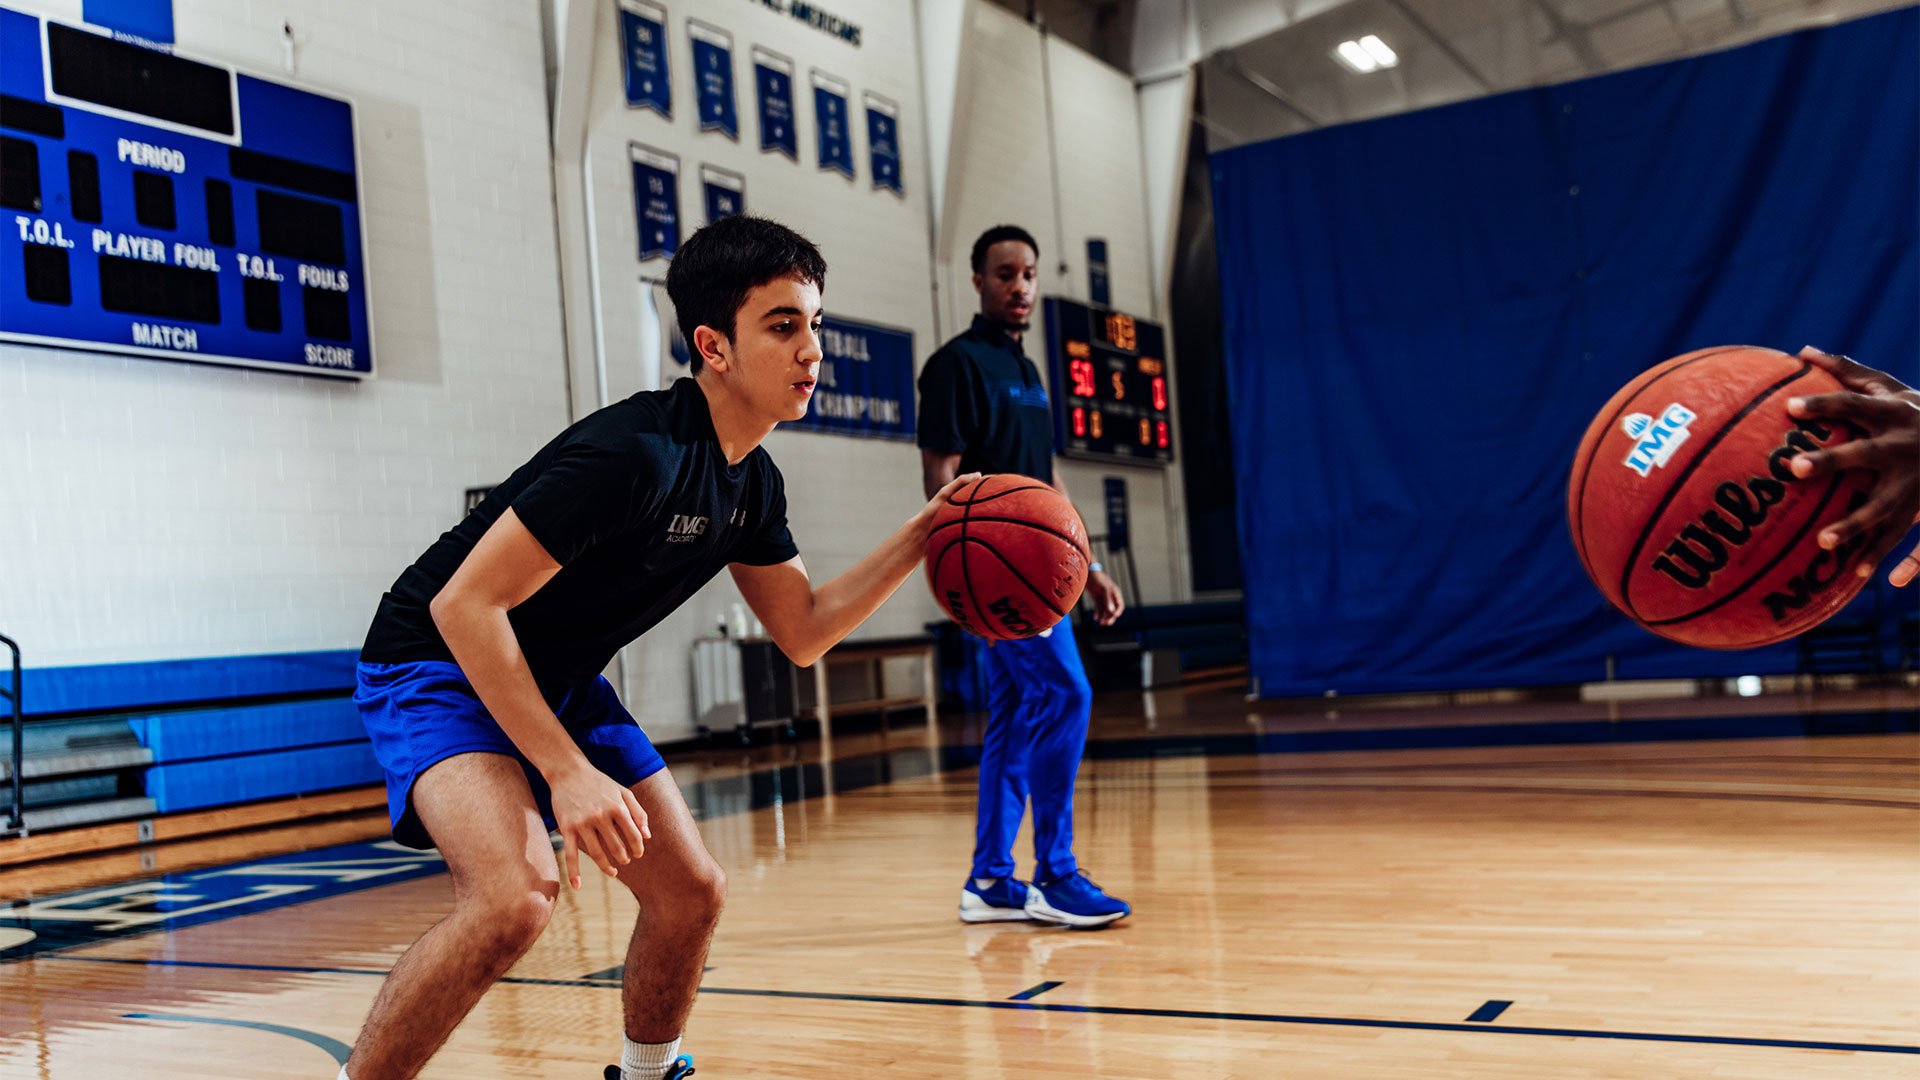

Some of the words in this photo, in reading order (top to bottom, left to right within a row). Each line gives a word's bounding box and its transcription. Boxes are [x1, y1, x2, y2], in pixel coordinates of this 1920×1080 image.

[117, 137, 186, 174] PERIOD
[15, 215, 75, 250] T.O.L.
[92, 228, 166, 263] PLAYER
[174, 242, 221, 272] FOUL
[237, 252, 284, 282] T.O.L.
[298, 263, 349, 292] FOULS
[131, 322, 198, 350] MATCH
[304, 342, 354, 369] SCORE
[1627, 405, 1692, 474] IMG
[1651, 419, 1833, 590] Wilson
[667, 514, 709, 535] IMG
